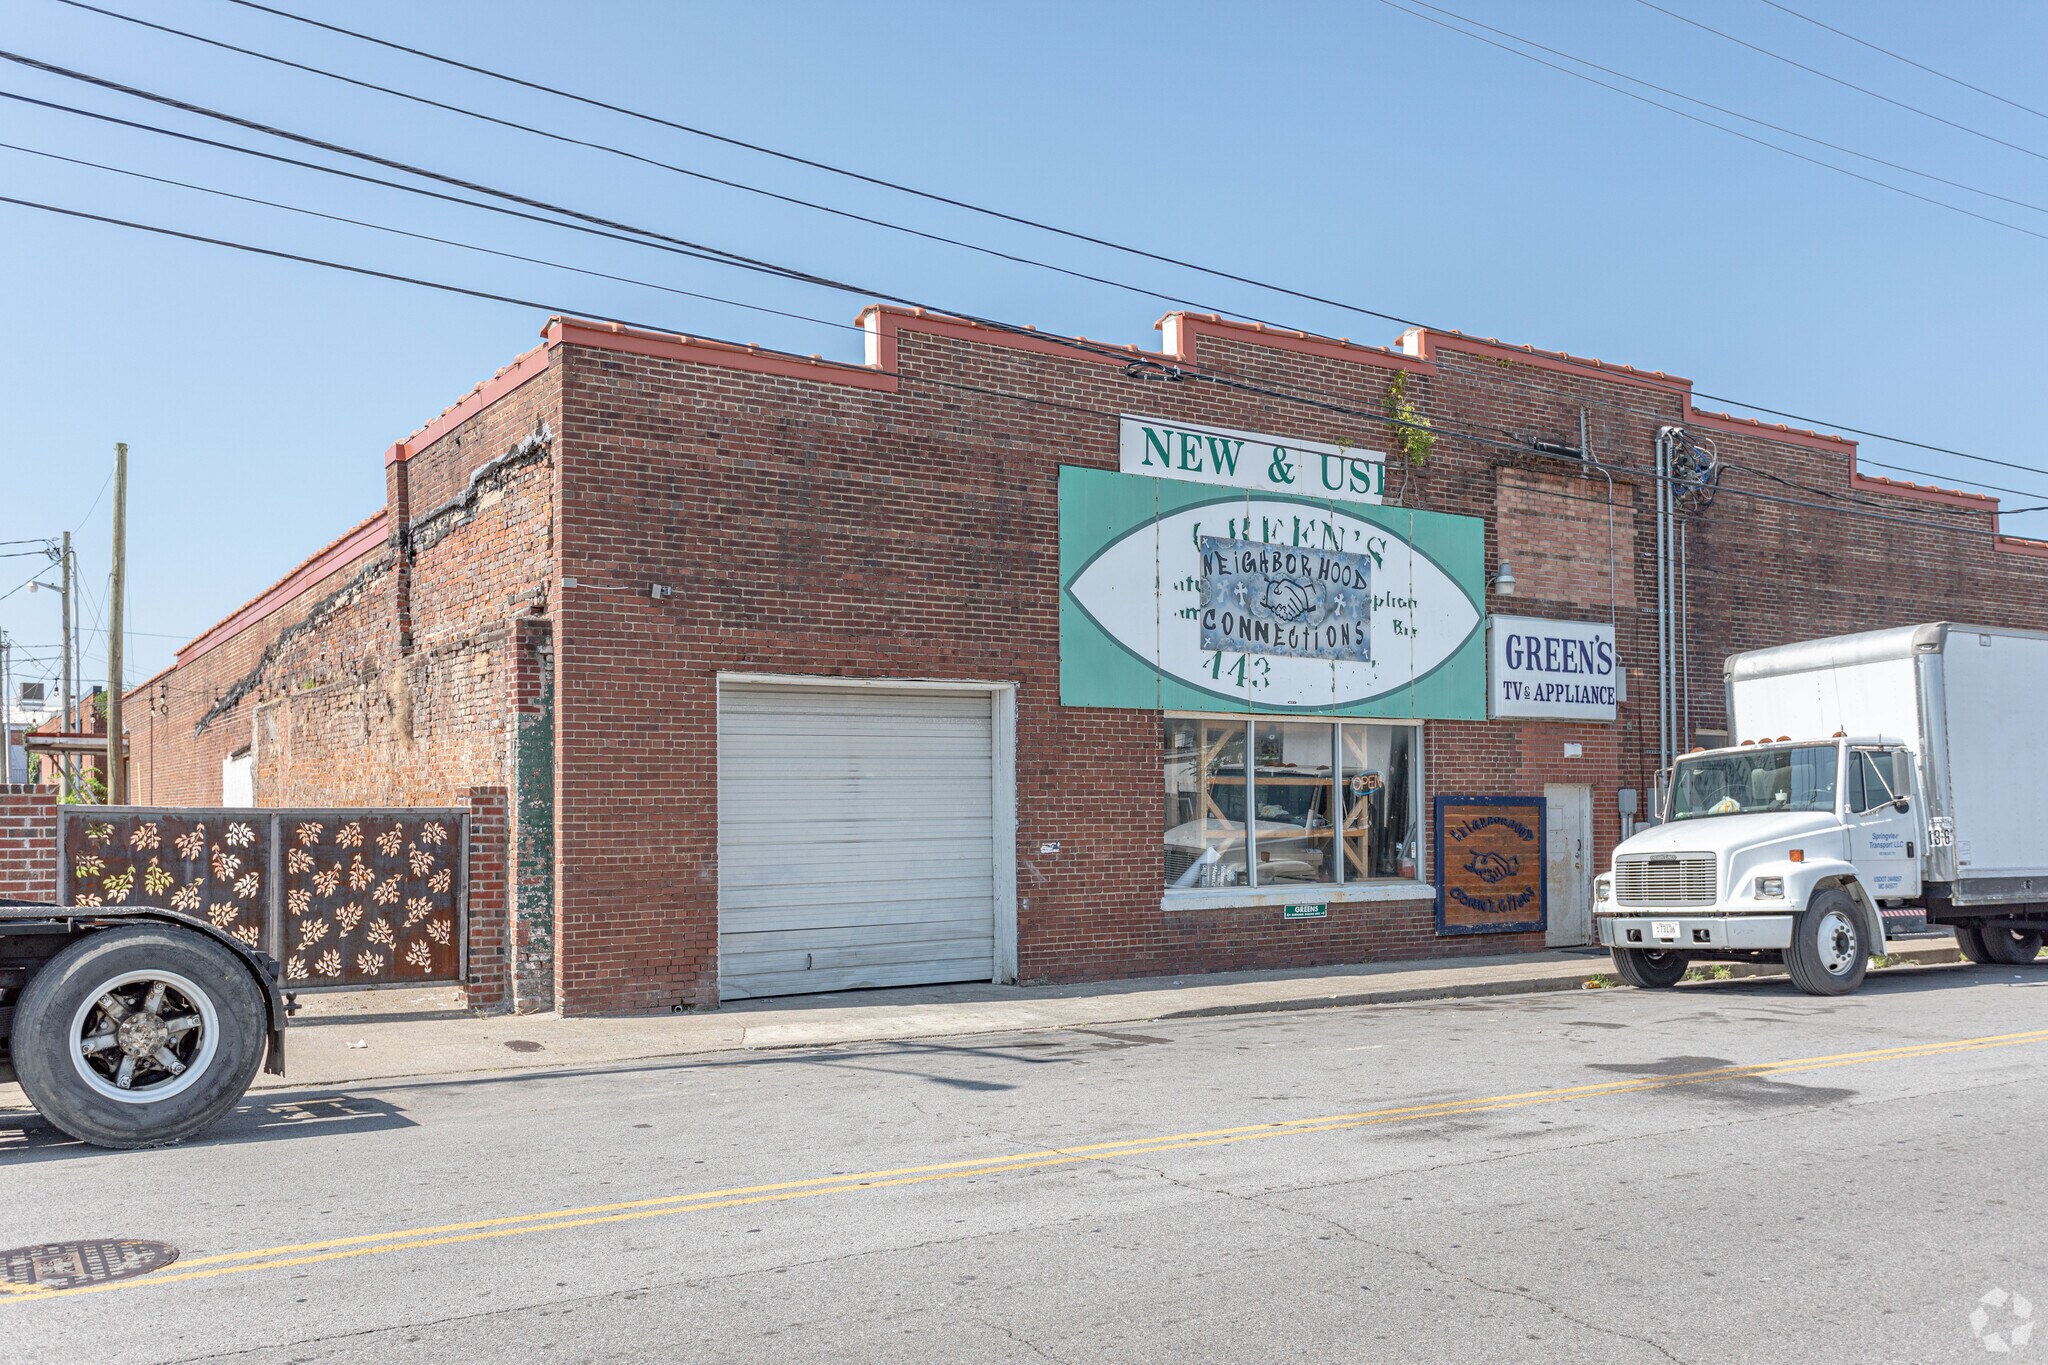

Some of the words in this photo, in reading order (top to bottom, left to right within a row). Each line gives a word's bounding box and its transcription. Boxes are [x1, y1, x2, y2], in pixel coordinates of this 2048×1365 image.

[1141, 427, 1245, 476] NEW
[1268, 447, 1296, 484] &
[1506, 634, 1612, 675] GREEN'S
[1534, 683, 1615, 705] APPLIANCE
[1352, 774, 1382, 791] OPEN
[1869, 841, 1893, 849] Transport
[1295, 905, 1319, 913] GREENS
